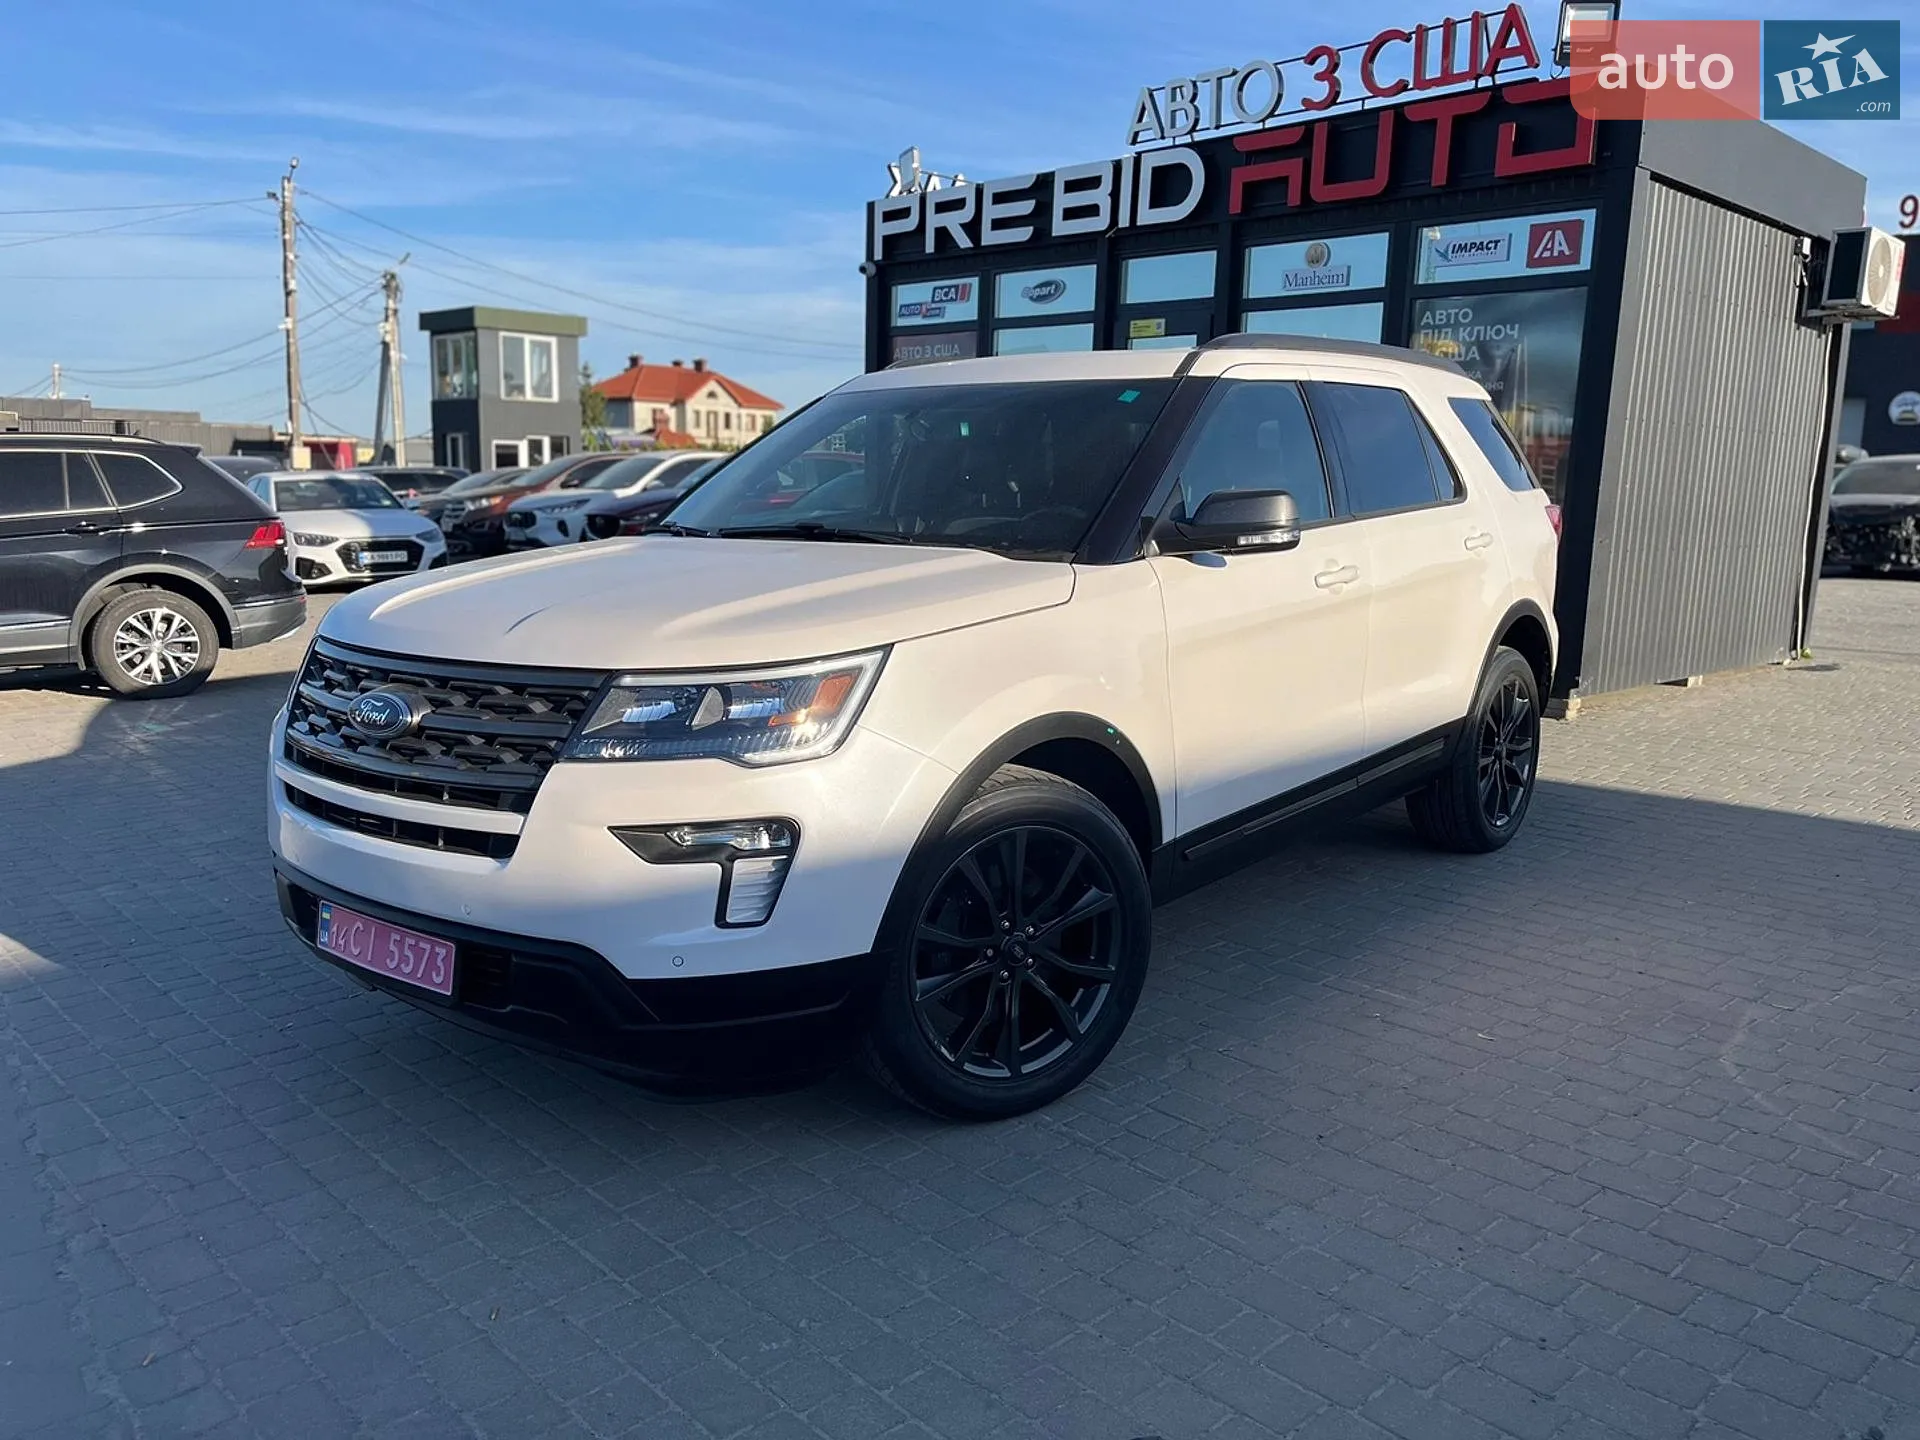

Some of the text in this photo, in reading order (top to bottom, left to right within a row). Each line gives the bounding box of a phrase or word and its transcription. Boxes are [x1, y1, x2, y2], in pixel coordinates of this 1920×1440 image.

[1126, 59, 1285, 146] АВТО
[1360, 3, 1541, 99] США
[1451, 239, 1501, 255] IMPACT
[1284, 269, 1345, 288] Manheim
[934, 286, 957, 301] BCA
[1420, 307, 1473, 326] АВТО
[1458, 323, 1519, 342] КЛЮЧ
[355, 698, 391, 726] Ford
[386, 932, 447, 985] 5573
